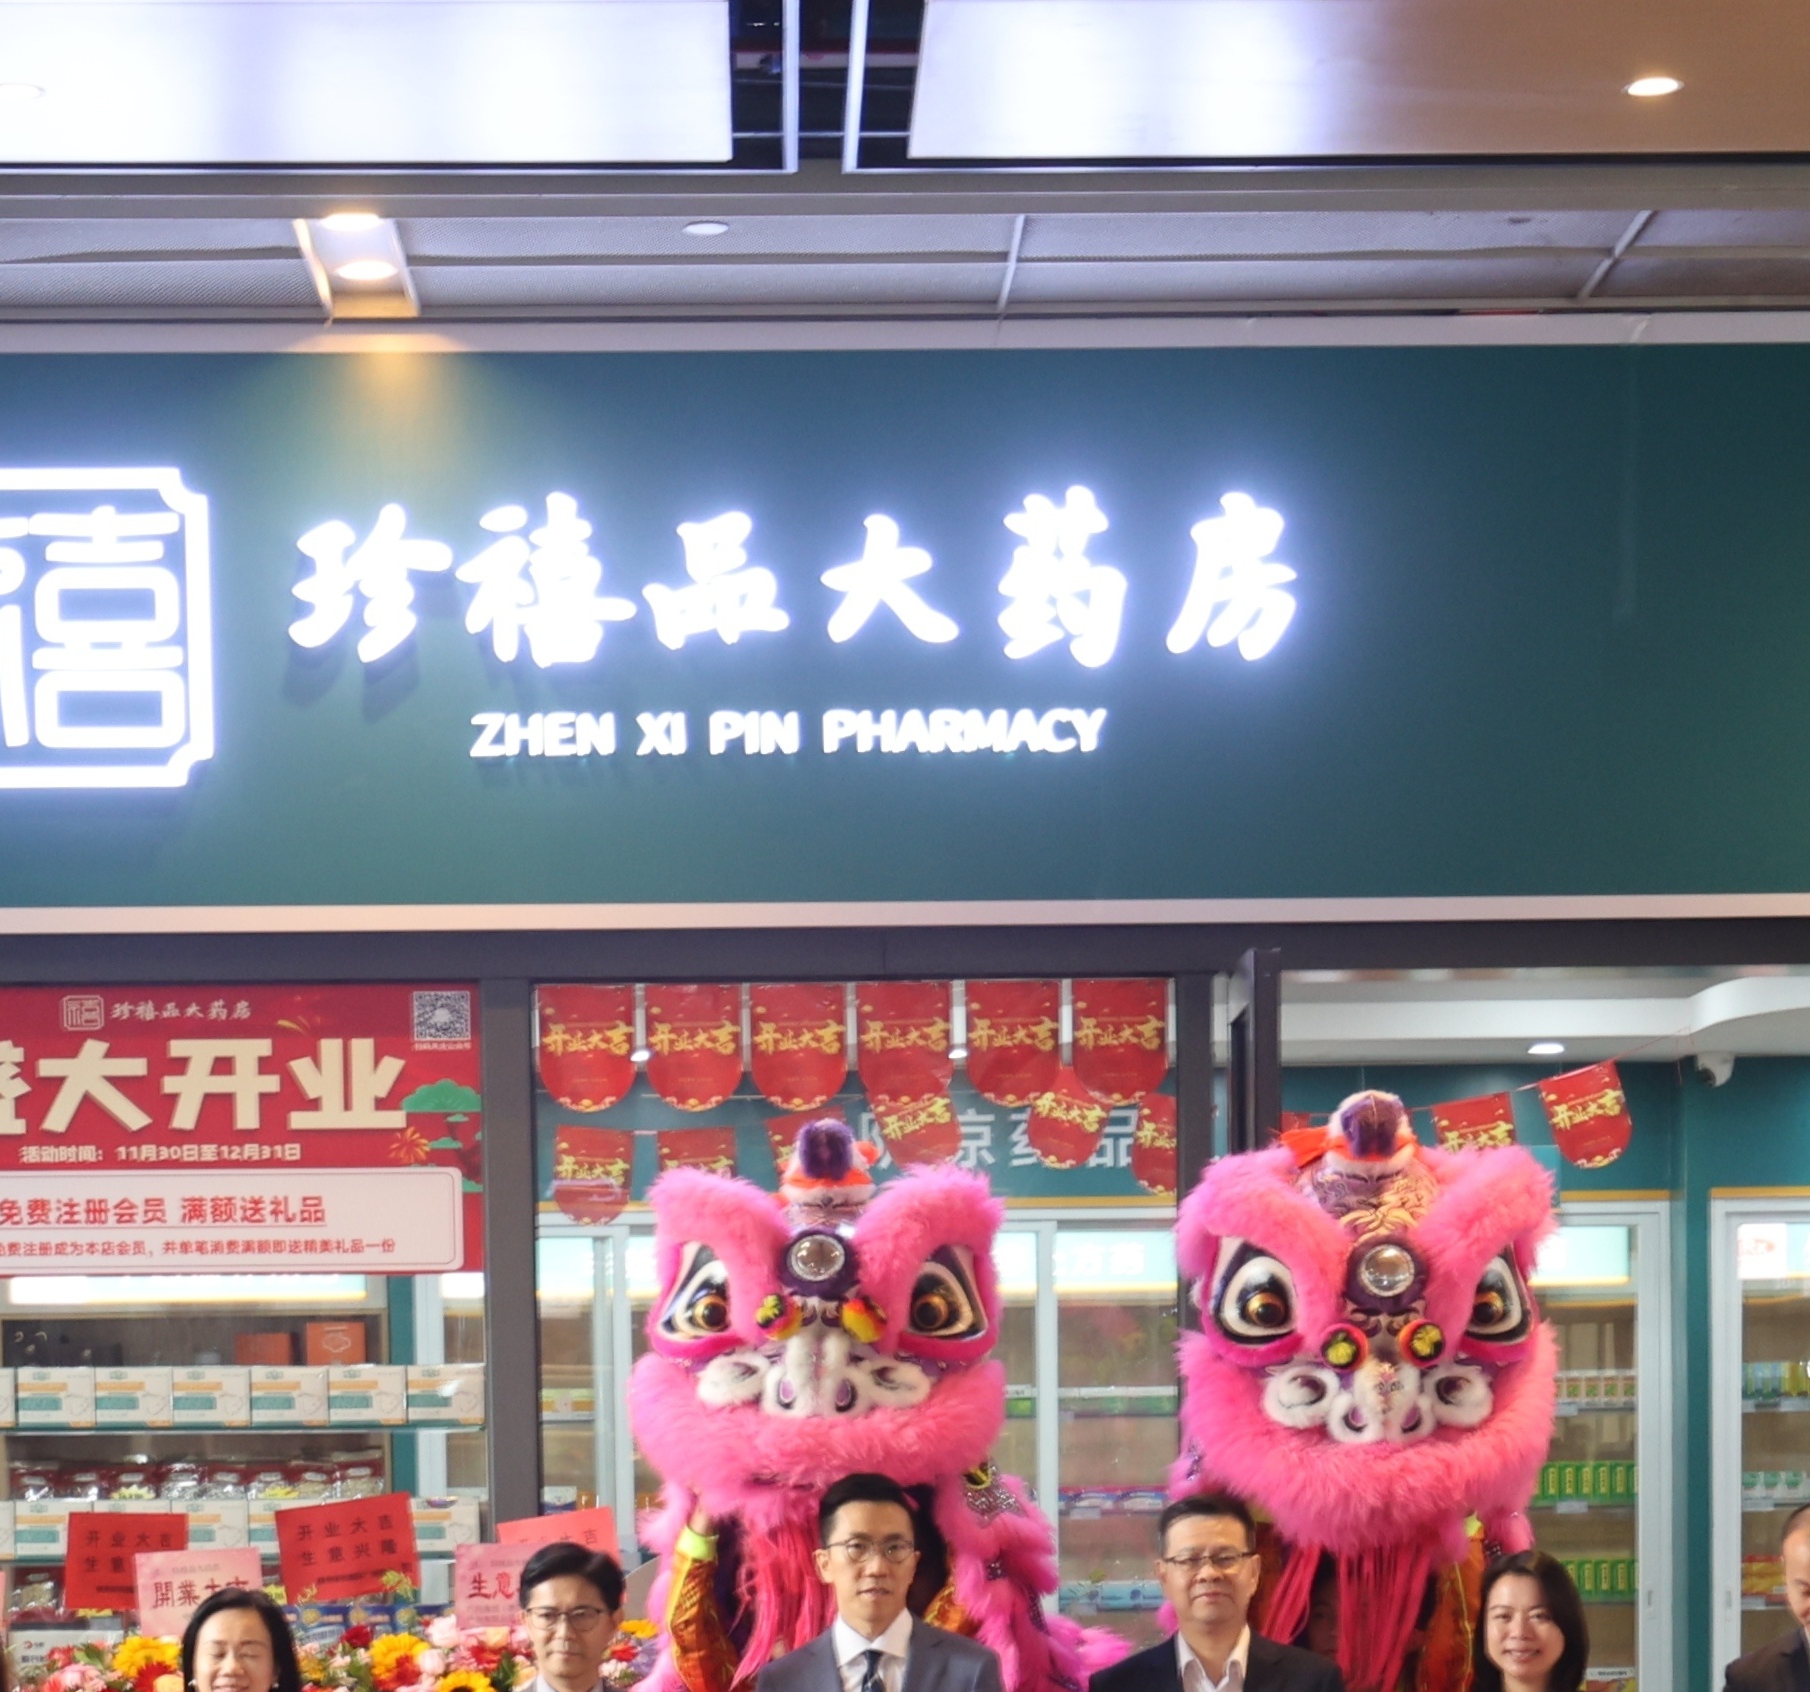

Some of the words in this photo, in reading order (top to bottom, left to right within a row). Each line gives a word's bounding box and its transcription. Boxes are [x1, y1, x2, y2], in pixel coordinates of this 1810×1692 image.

[288, 491, 1298, 669] 珍禧品大药房
[470, 712, 616, 757] ZHEN
[636, 711, 687, 756] XI
[709, 710, 799, 755] PIN
[822, 708, 1107, 755] PHARMACY
[109, 999, 253, 1021] 珍禧品大药房
[541, 1019, 635, 1056] 开业大吉
[647, 1019, 741, 1056] 开业大吉
[752, 1019, 846, 1056] 开业大吉
[860, 1017, 952, 1053] 开业大吉
[969, 1016, 1058, 1052] 开业大吉
[1074, 1015, 1166, 1051] 开业大吉
[883, 1098, 951, 1141] 开业大吉
[1549, 1088, 1627, 1131] 开业大吉
[180, 1195, 327, 1225] 满额送礼品
[297, 1513, 394, 1542] 开业大吉
